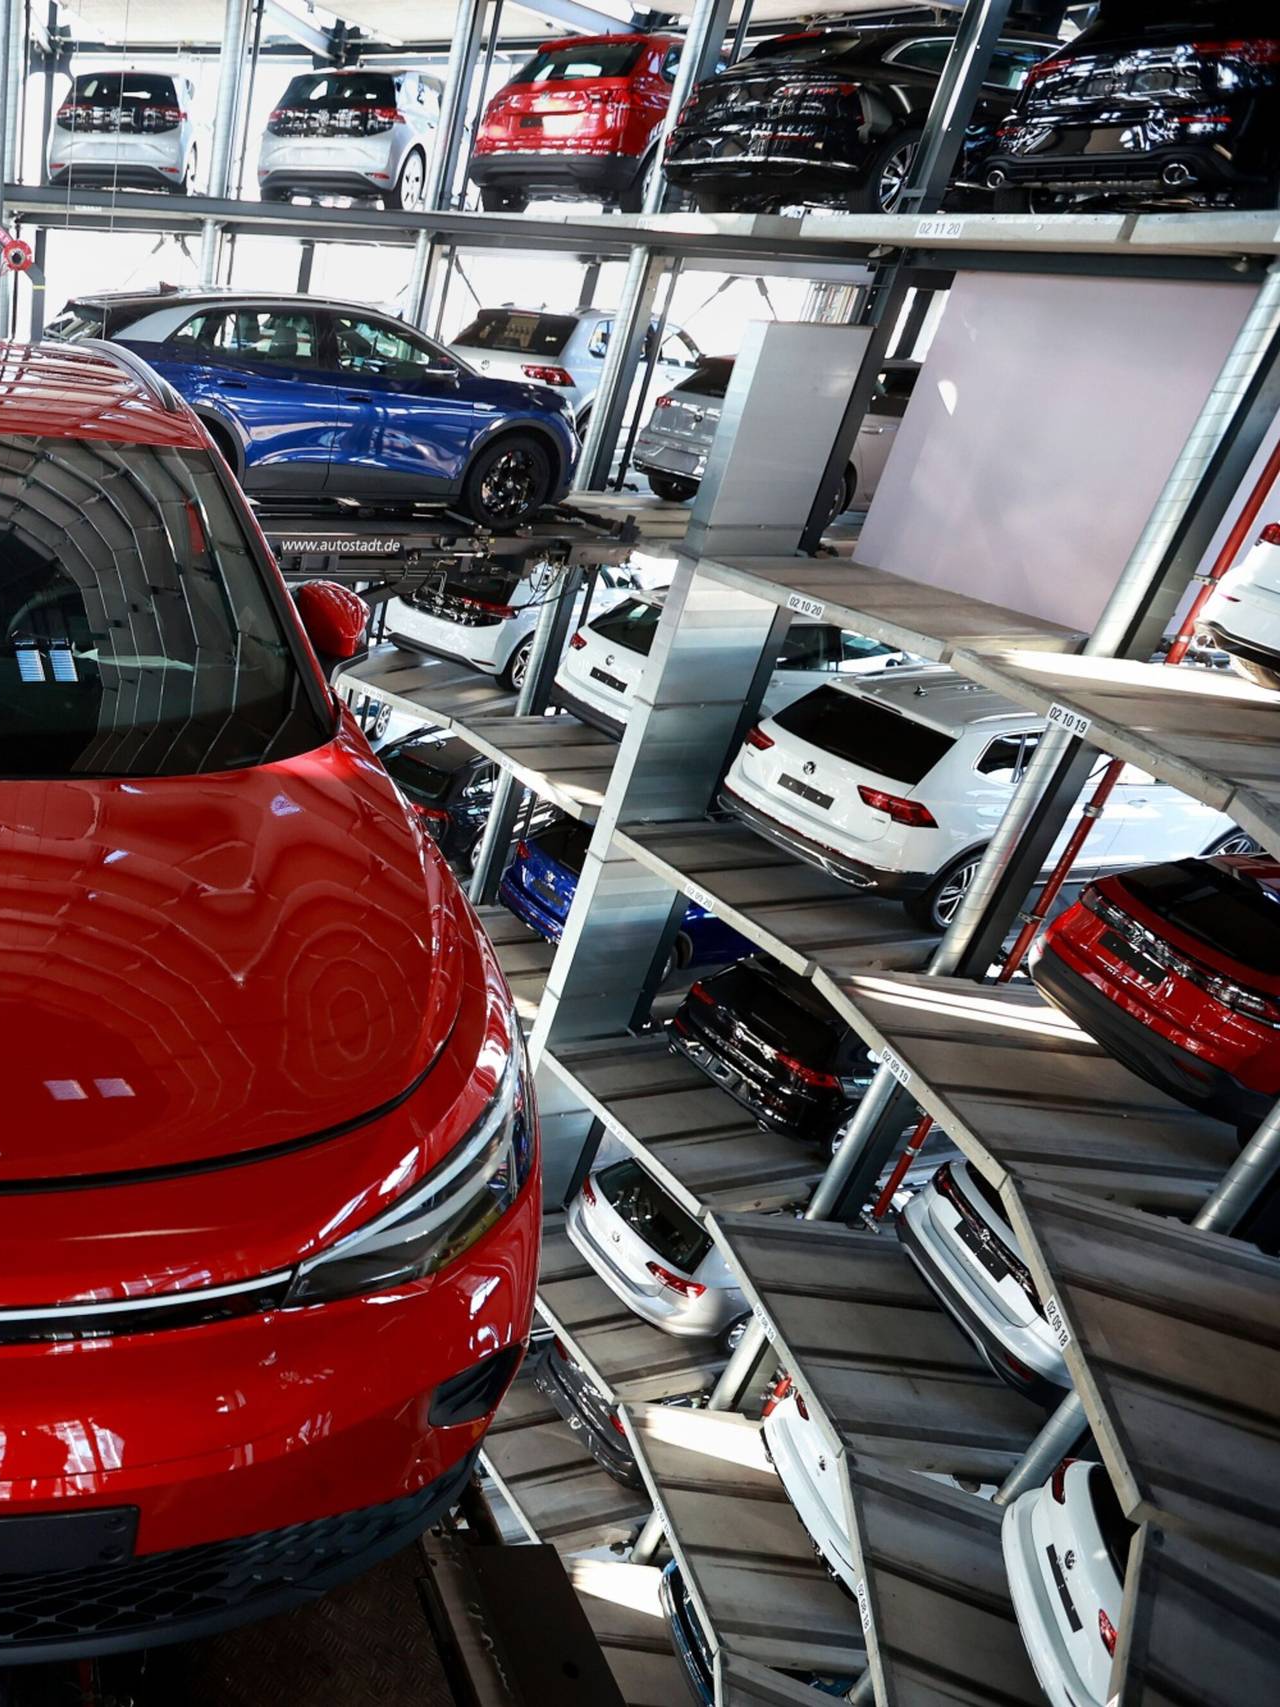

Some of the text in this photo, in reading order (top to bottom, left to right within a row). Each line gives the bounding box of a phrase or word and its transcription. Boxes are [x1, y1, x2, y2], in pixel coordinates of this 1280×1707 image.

[918, 223, 960, 237] 02 11 20
[281, 538, 401, 554] www.autostadt.de
[789, 596, 823, 617] 02 10 20
[1048, 706, 1088, 734] 02 10 19
[685, 885, 695, 896] 02
[703, 898, 713, 909] 20
[881, 1050, 909, 1083] 02 09 19
[1046, 1300, 1068, 1347] 02 09 18
